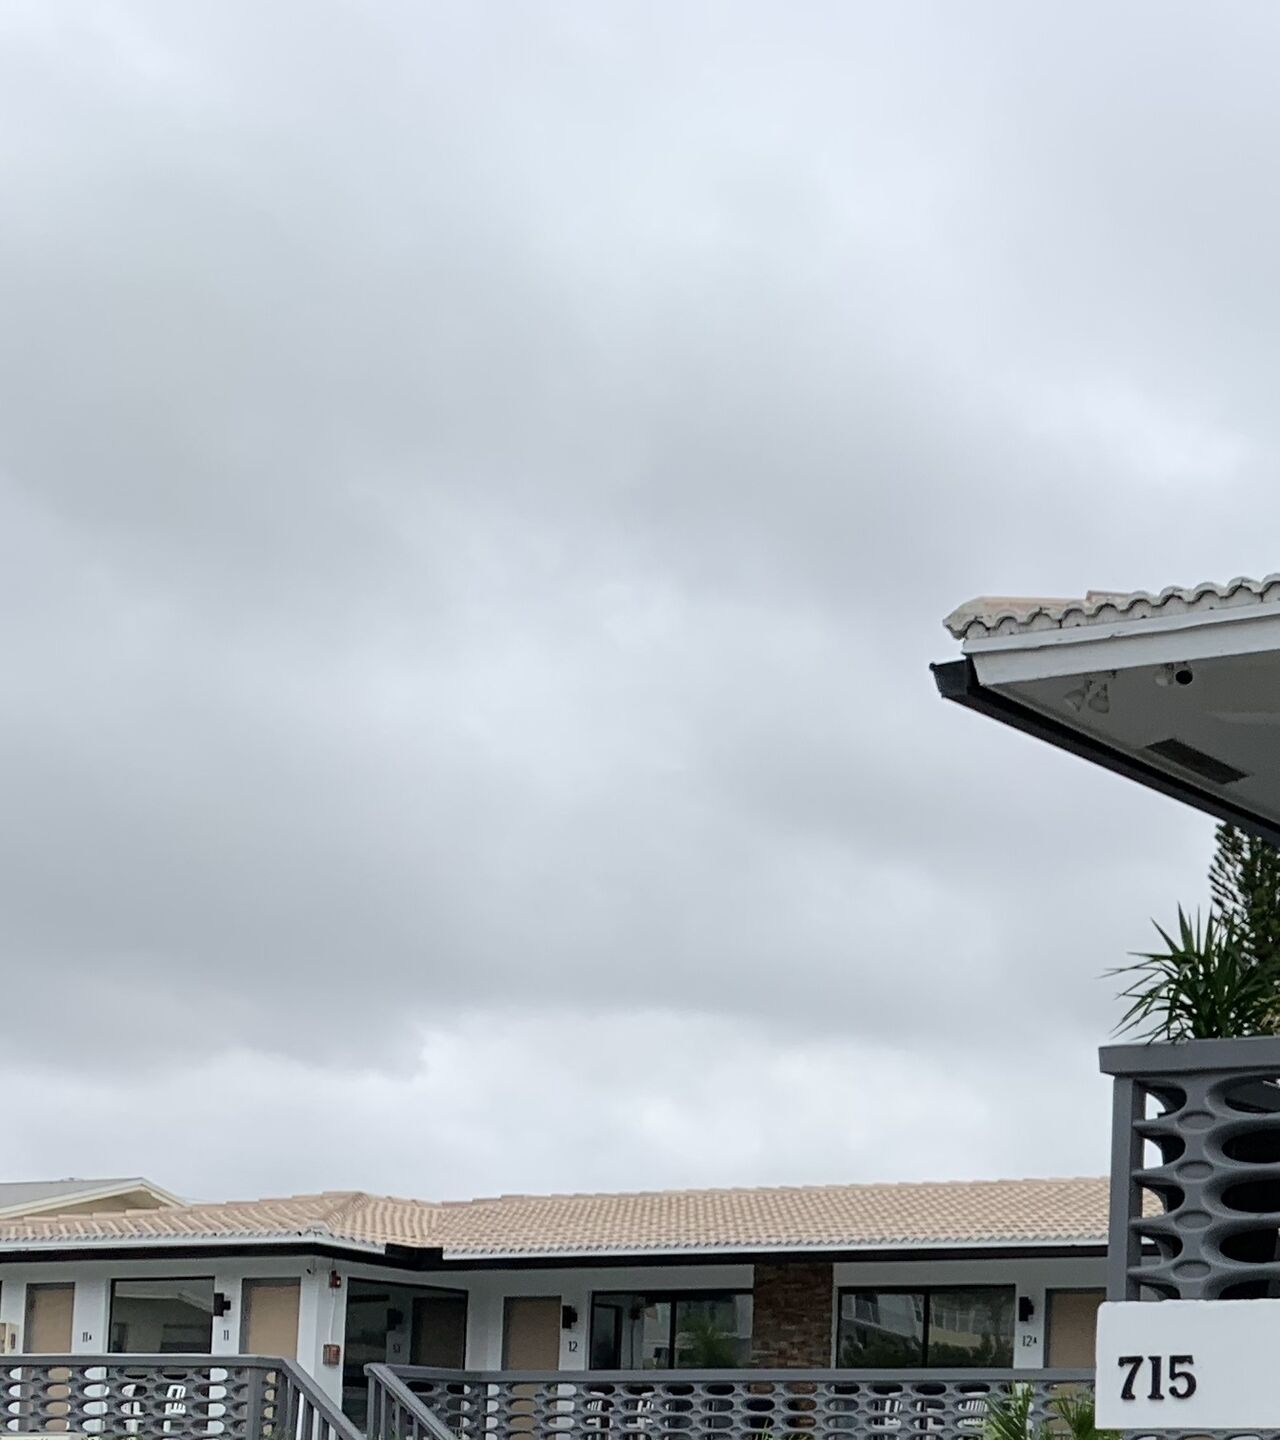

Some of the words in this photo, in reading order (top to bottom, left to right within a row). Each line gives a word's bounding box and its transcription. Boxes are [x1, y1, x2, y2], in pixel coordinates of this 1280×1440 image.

[223, 1330, 229, 1341] 11
[1022, 1335, 1037, 1347] 12A
[568, 1341, 578, 1352] 12
[1117, 1354, 1197, 1401] 715
